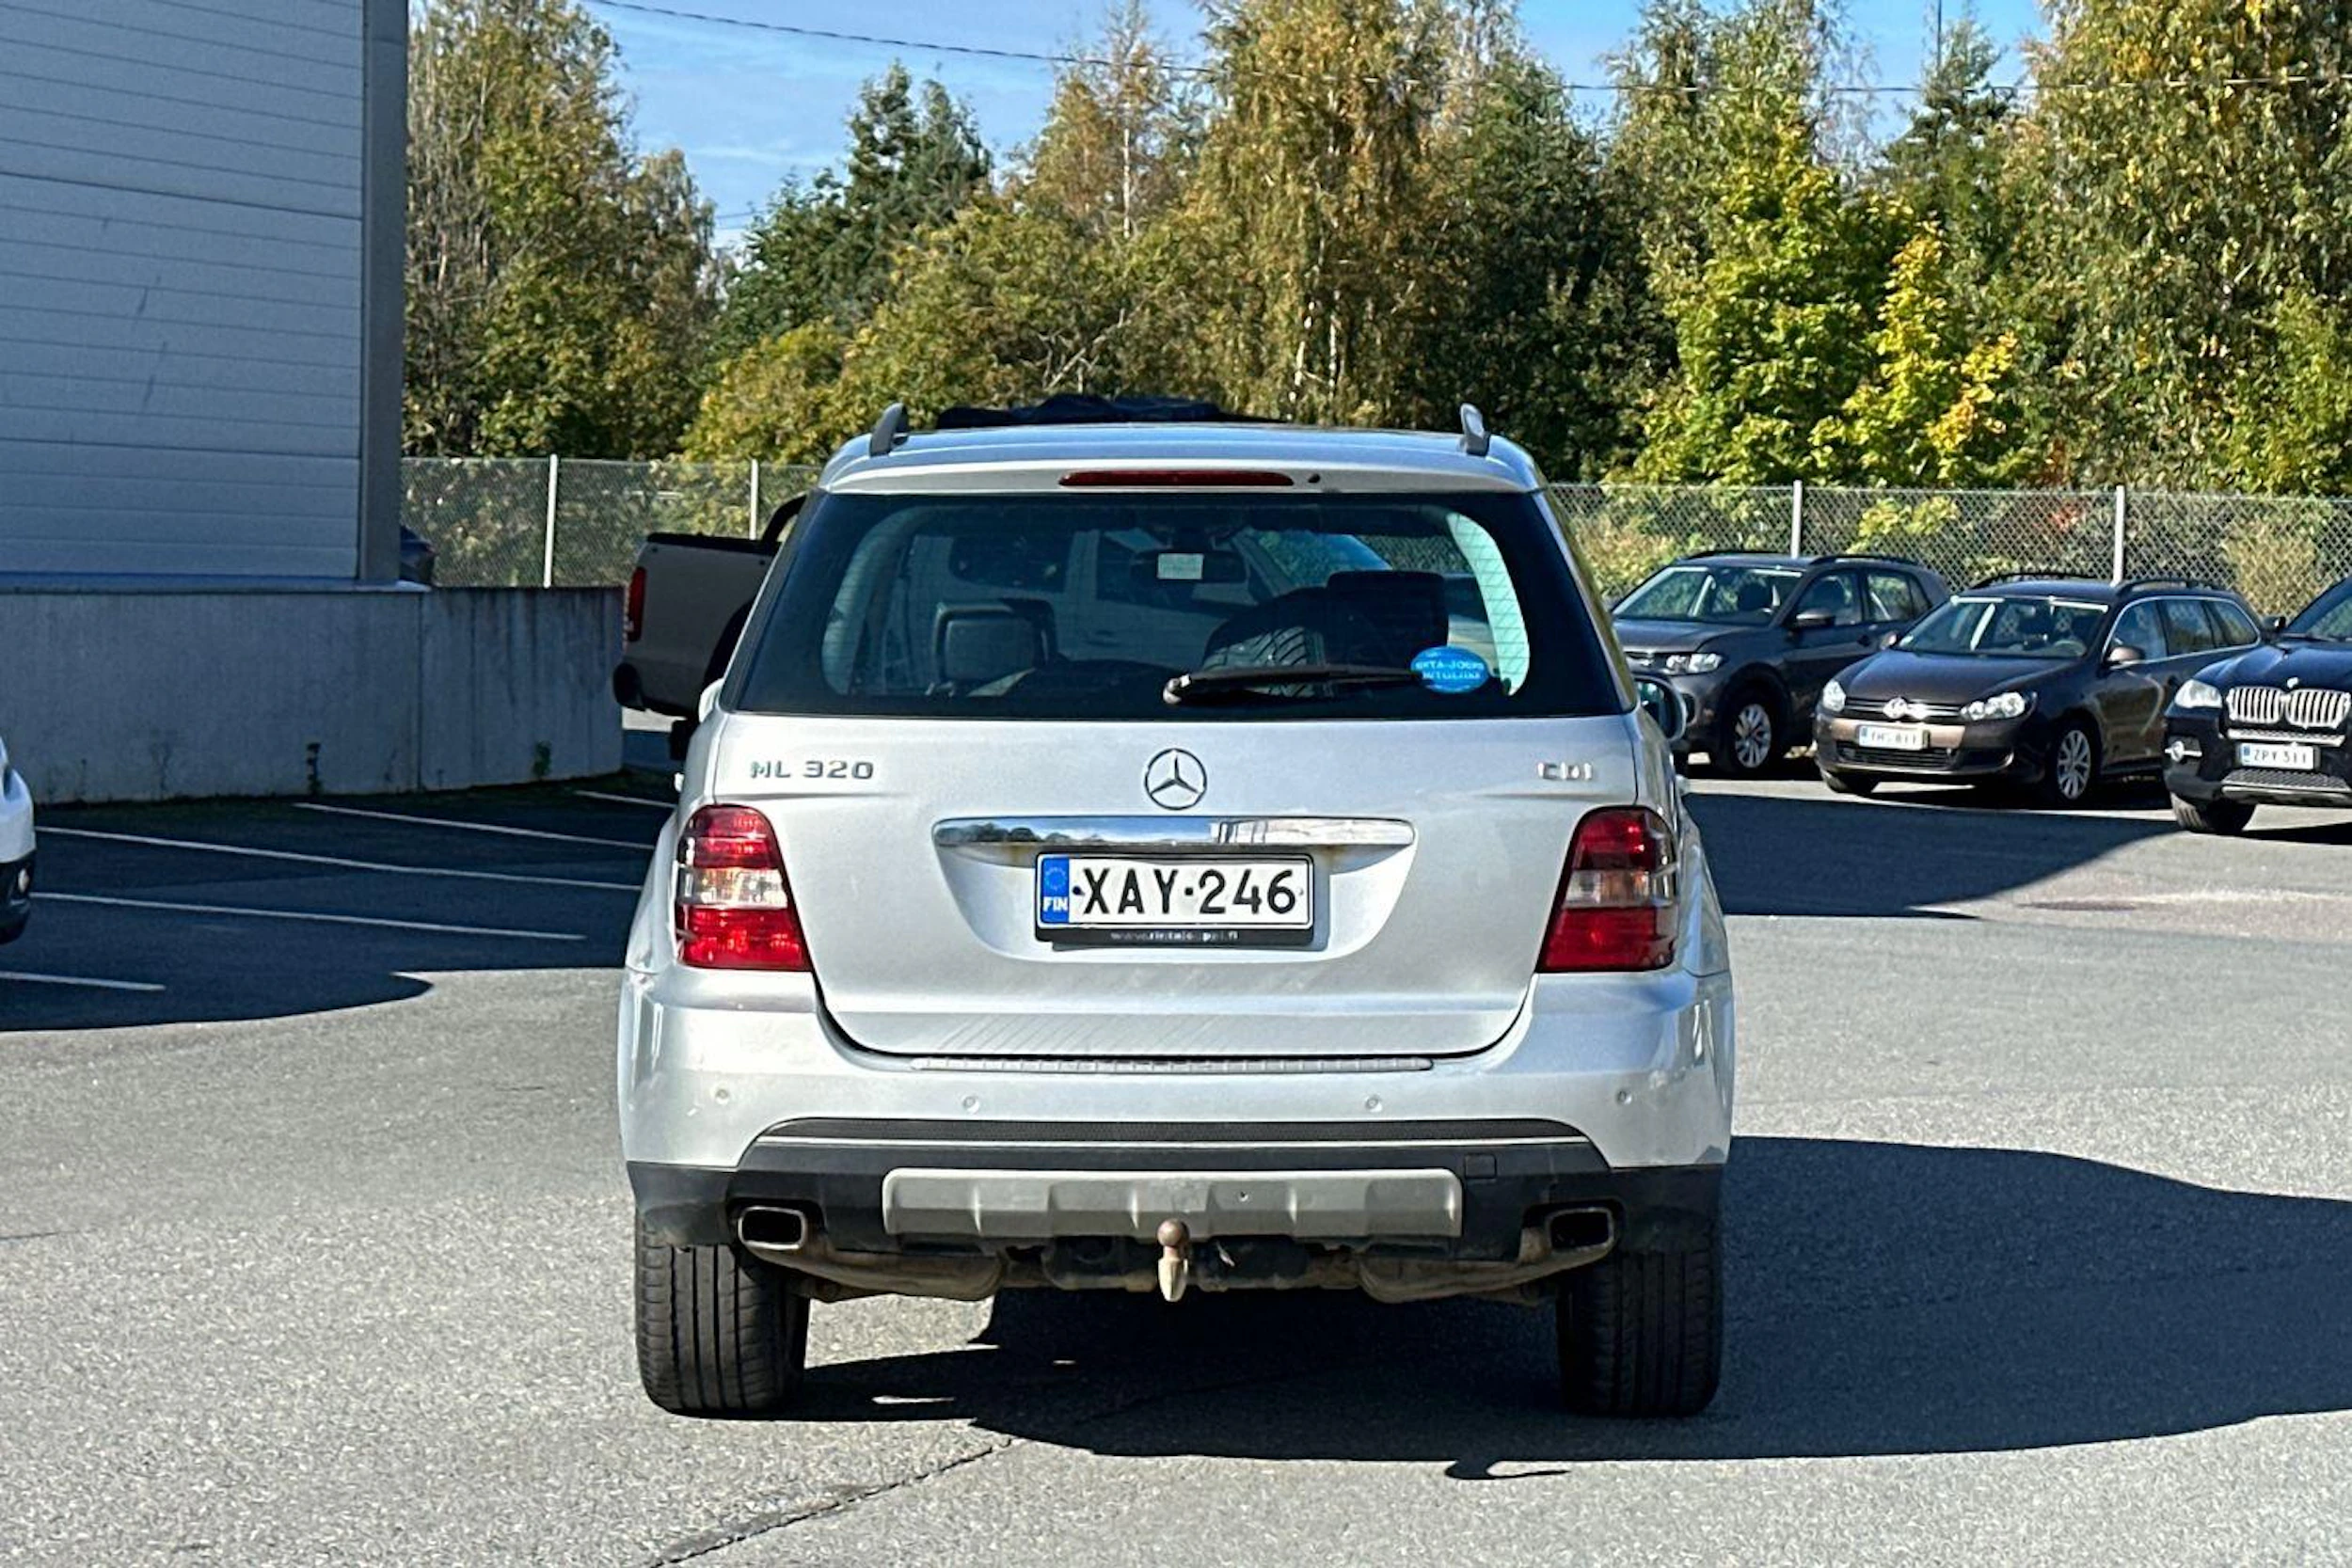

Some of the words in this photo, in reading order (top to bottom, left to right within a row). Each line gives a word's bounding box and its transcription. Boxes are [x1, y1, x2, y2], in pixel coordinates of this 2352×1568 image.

[750, 760, 791, 779] ML
[803, 760, 874, 780] 320
[1537, 761, 1592, 781] CDI
[1042, 896, 1069, 911] FIN
